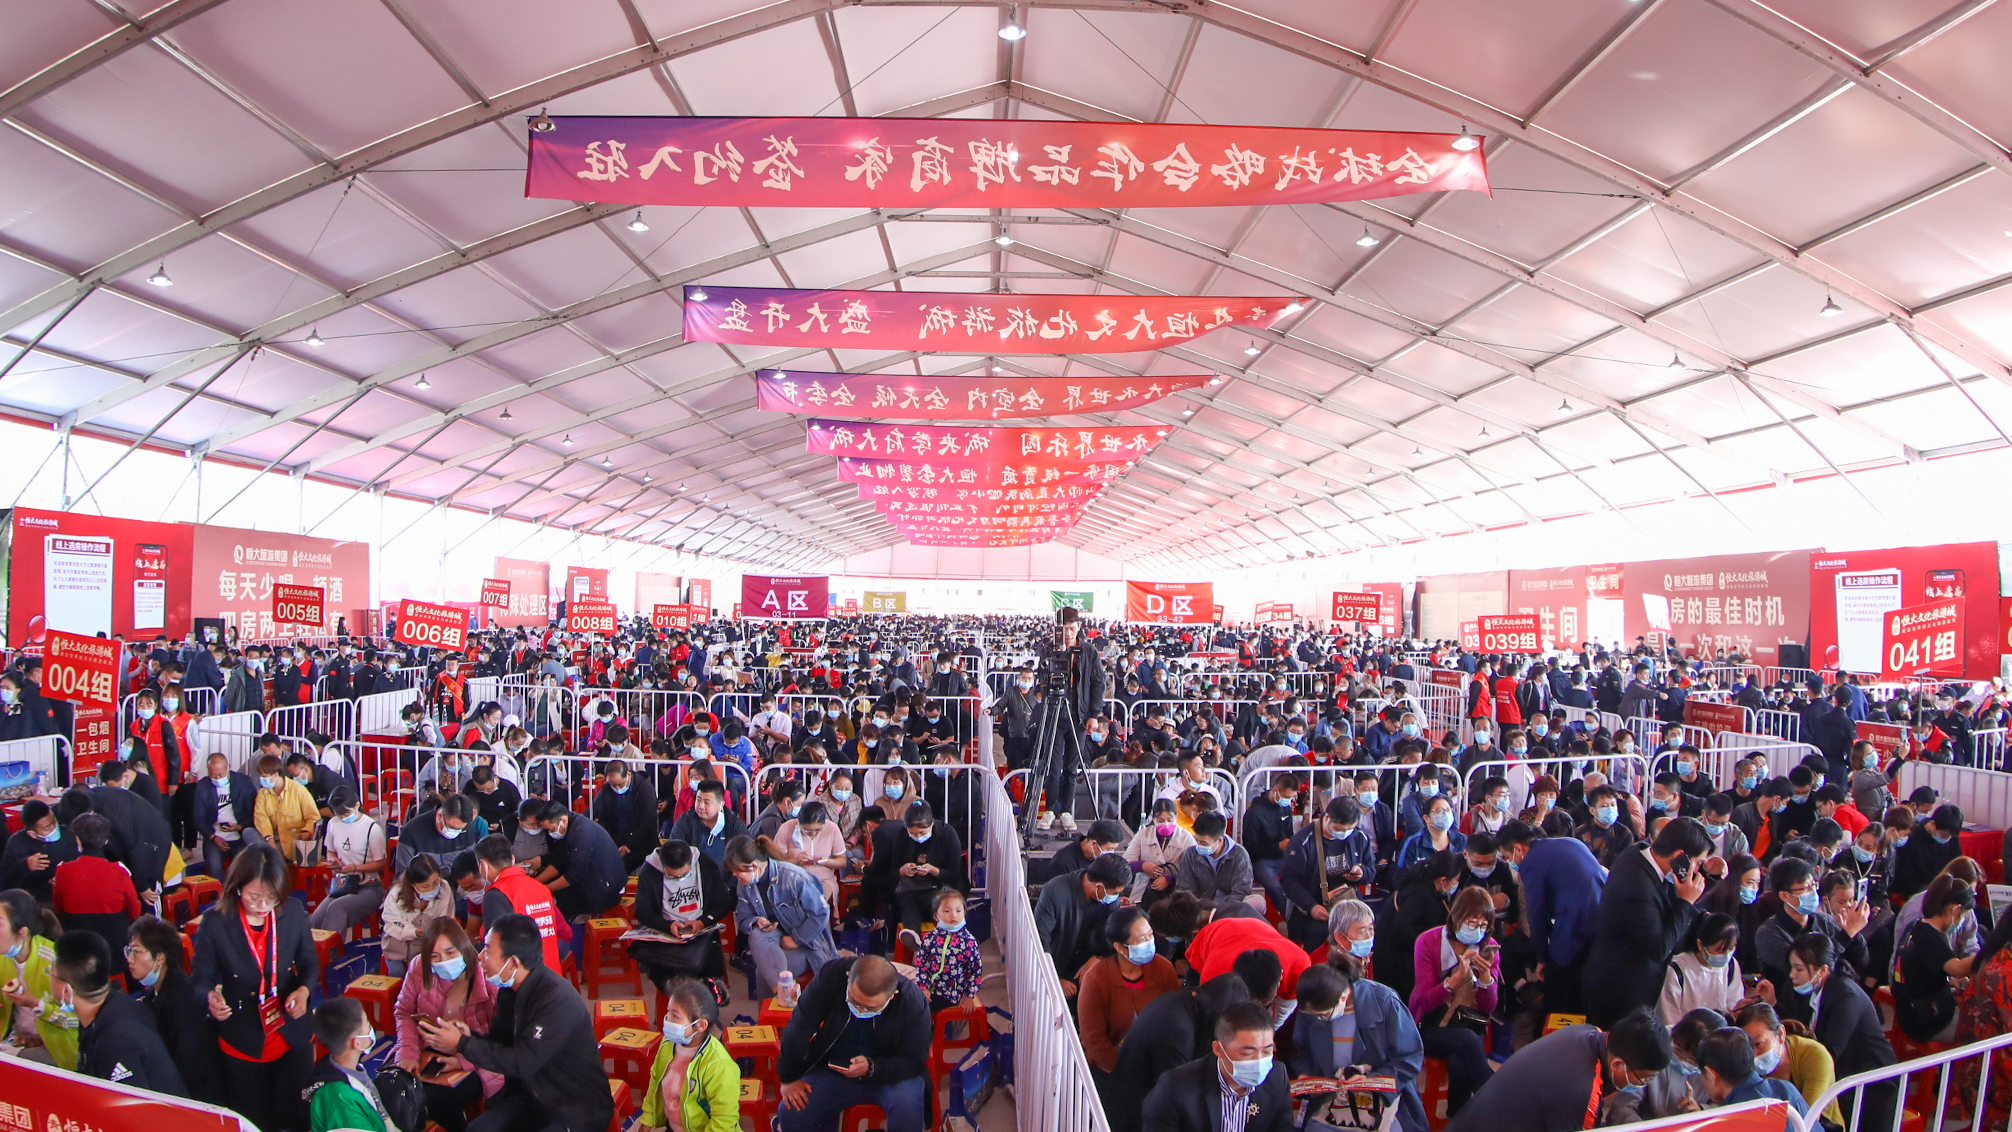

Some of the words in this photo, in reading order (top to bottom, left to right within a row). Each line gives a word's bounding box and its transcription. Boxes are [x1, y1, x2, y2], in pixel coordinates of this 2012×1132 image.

[55, 540, 107, 553] 线上选房操作流程
[245, 548, 288, 563] 恒大旅游集团
[1587, 573, 1619, 590] 卫生间
[1674, 573, 1714, 586] 恒大旅游集团
[483, 591, 508, 606] 007组
[761, 589, 781, 609] A
[787, 590, 809, 611] 区
[872, 597, 882, 609] B
[885, 598, 897, 609] 区
[1072, 598, 1084, 609] 区
[1147, 594, 1165, 614] D
[1172, 595, 1194, 616] 区
[277, 602, 320, 623] 005组
[414, 604, 463, 622] 恒大文化旅游城
[1157, 615, 1184, 623] 33-42
[1336, 605, 1377, 620] 037组
[1901, 604, 1957, 628] 恒大文化旅游城
[572, 616, 614, 630] 008组
[656, 615, 687, 627] 010组
[403, 620, 462, 647] 006组
[1484, 632, 1537, 650] 039组
[60, 637, 114, 661] 恒大文化旅游城
[1890, 630, 1956, 672] 041组
[48, 663, 113, 703] 004组
[76, 739, 110, 757] 卫生间
[362, 980, 382, 988] 04
[609, 1003, 625, 1012] 04
[614, 1031, 636, 1042] 04
[736, 1029, 753, 1039] 04
